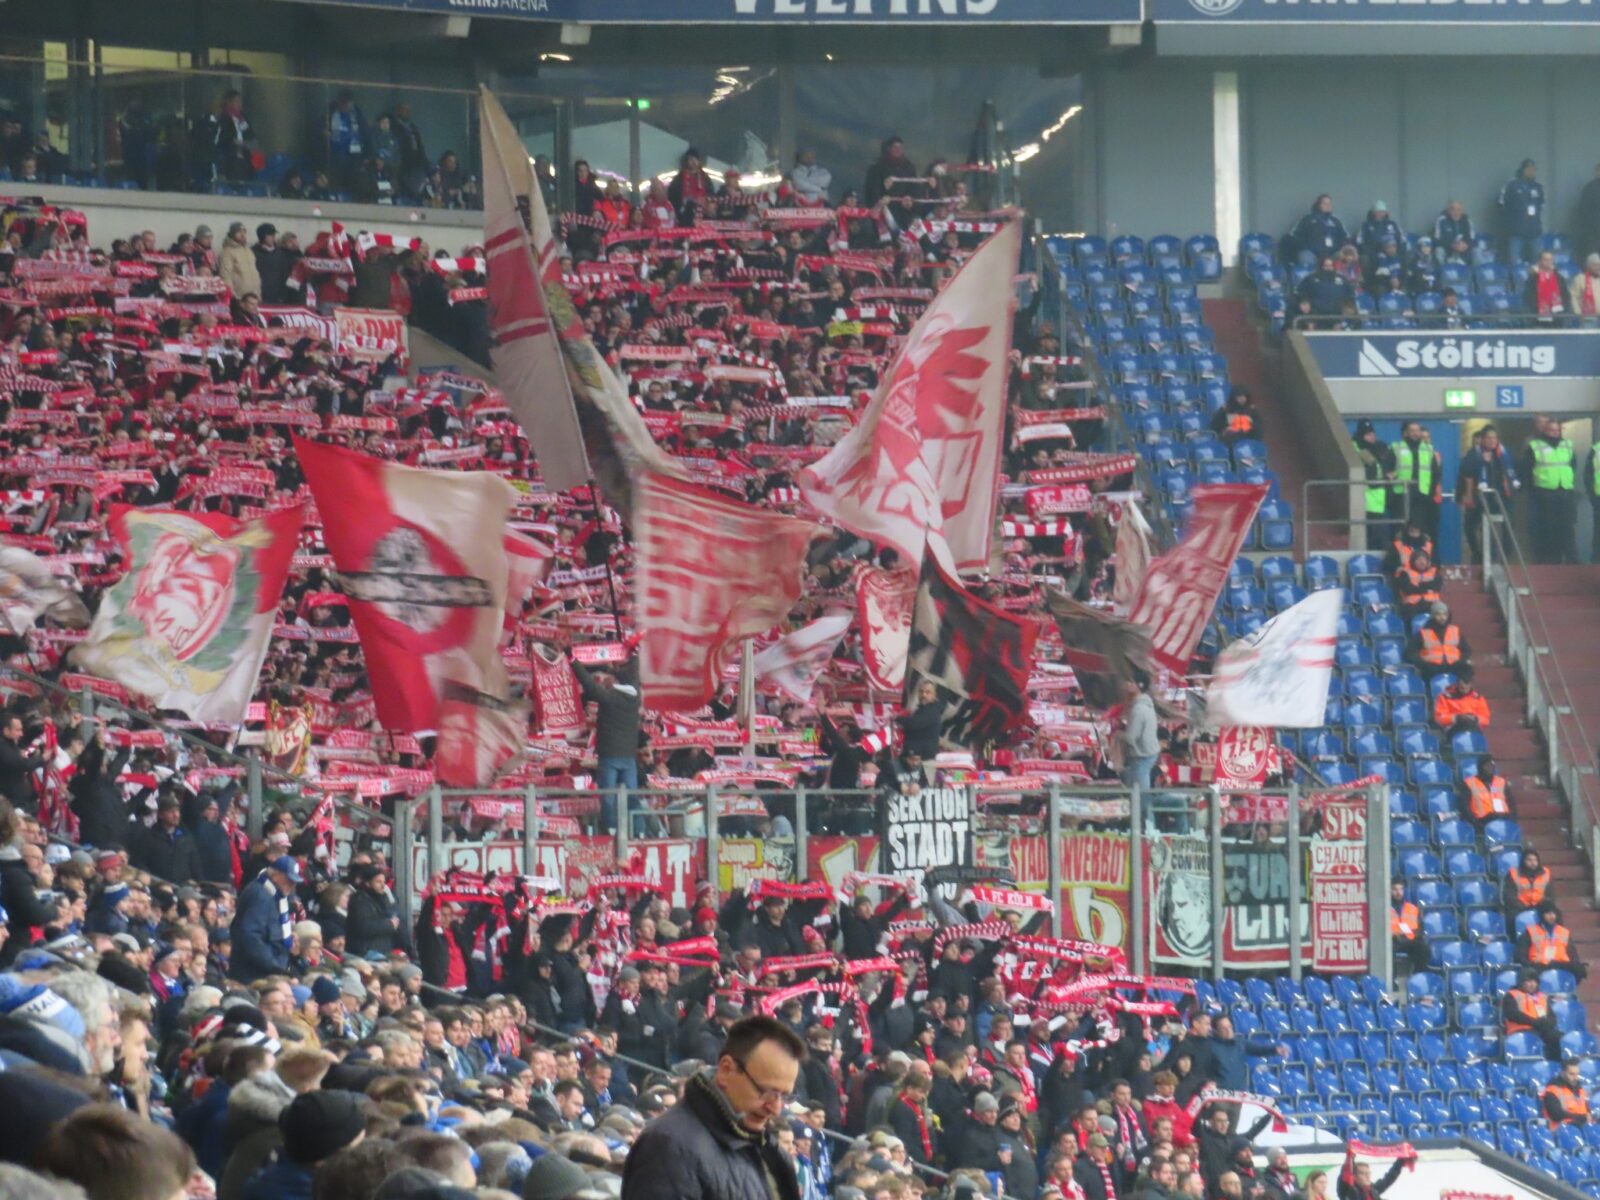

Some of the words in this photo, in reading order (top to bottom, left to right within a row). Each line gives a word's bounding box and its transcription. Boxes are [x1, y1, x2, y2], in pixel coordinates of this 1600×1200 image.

[1395, 338, 1556, 374] Stölting
[1500, 388, 1520, 405] S1
[887, 787, 969, 824] SEKTION
[888, 821, 969, 869] STADT
[1010, 836, 1129, 885] STADNVERBOT
[992, 891, 1005, 905] FC
[1007, 891, 1033, 907] KÖLN
